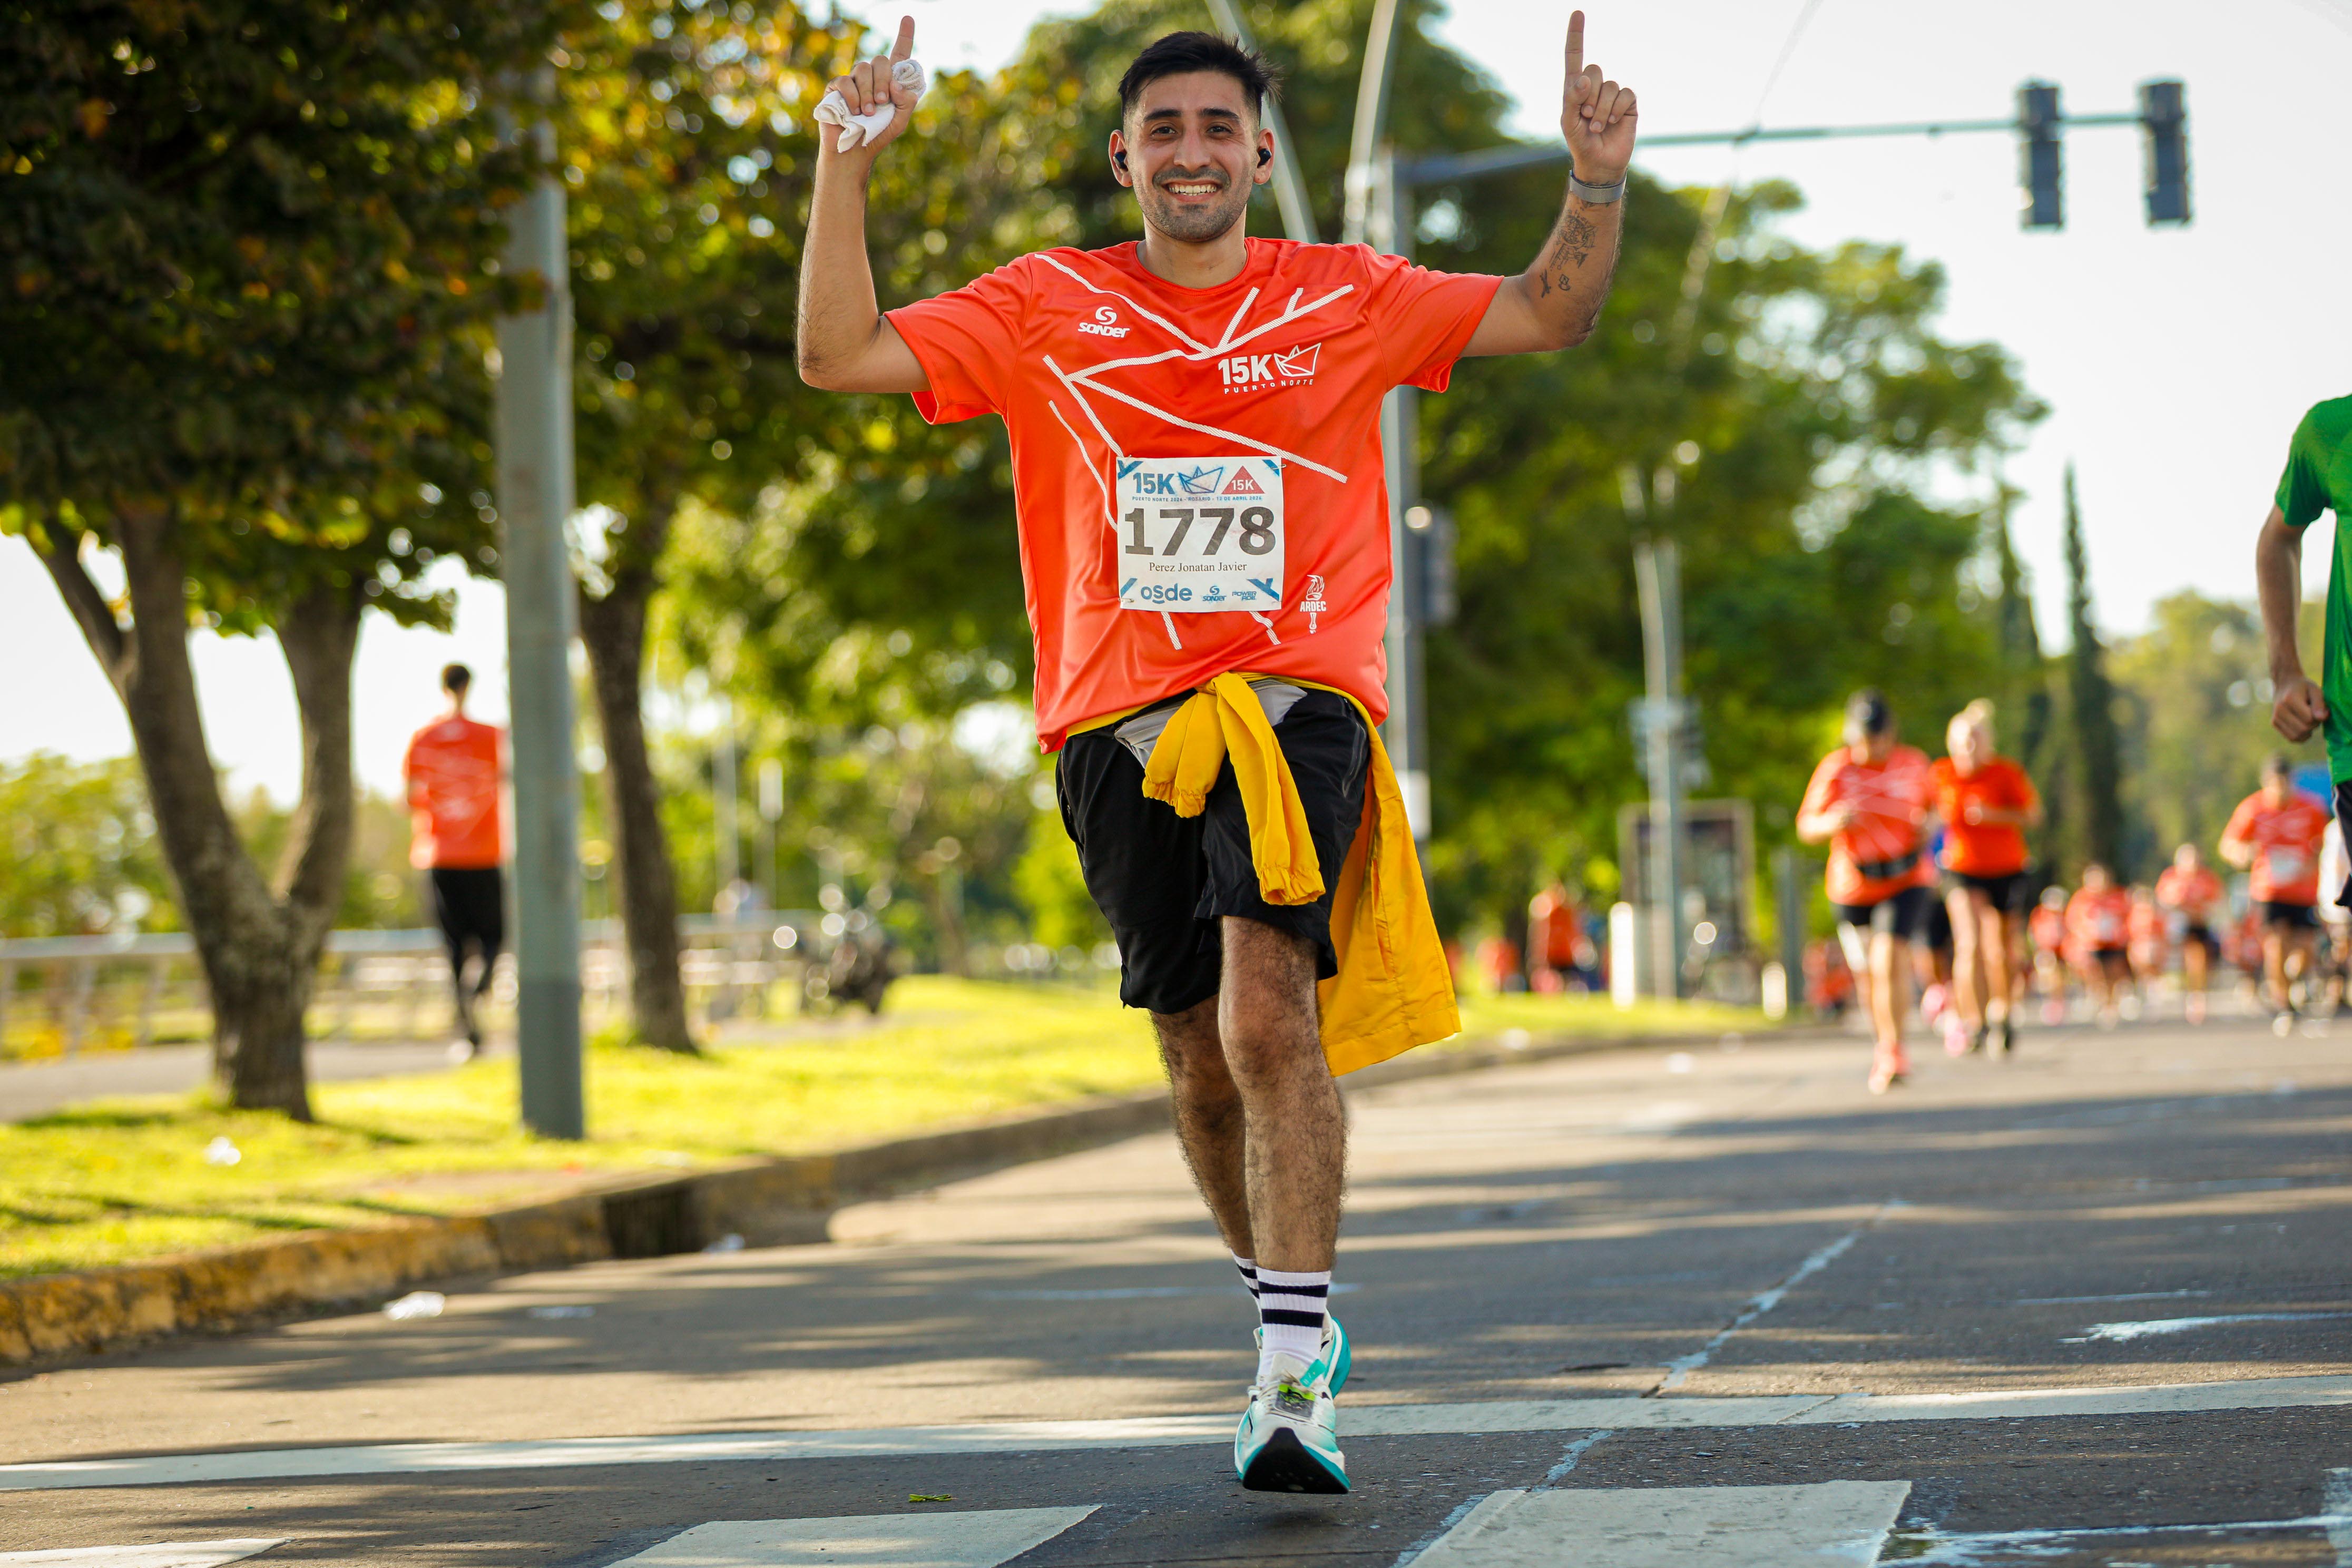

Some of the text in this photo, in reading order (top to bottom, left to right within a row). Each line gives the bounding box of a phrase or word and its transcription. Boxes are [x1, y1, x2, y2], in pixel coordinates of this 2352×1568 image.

[1218, 354, 1274, 385] 15K
[1224, 383, 1276, 395] PUERTO
[1133, 473, 1175, 494] 15K
[1231, 479, 1255, 491] 15K
[1125, 506, 1276, 556] 1778
[1149, 561, 1247, 572] Perez Jonatan Javier
[1141, 583, 1192, 602] osde
[1300, 601, 1327, 612] ARDEC
